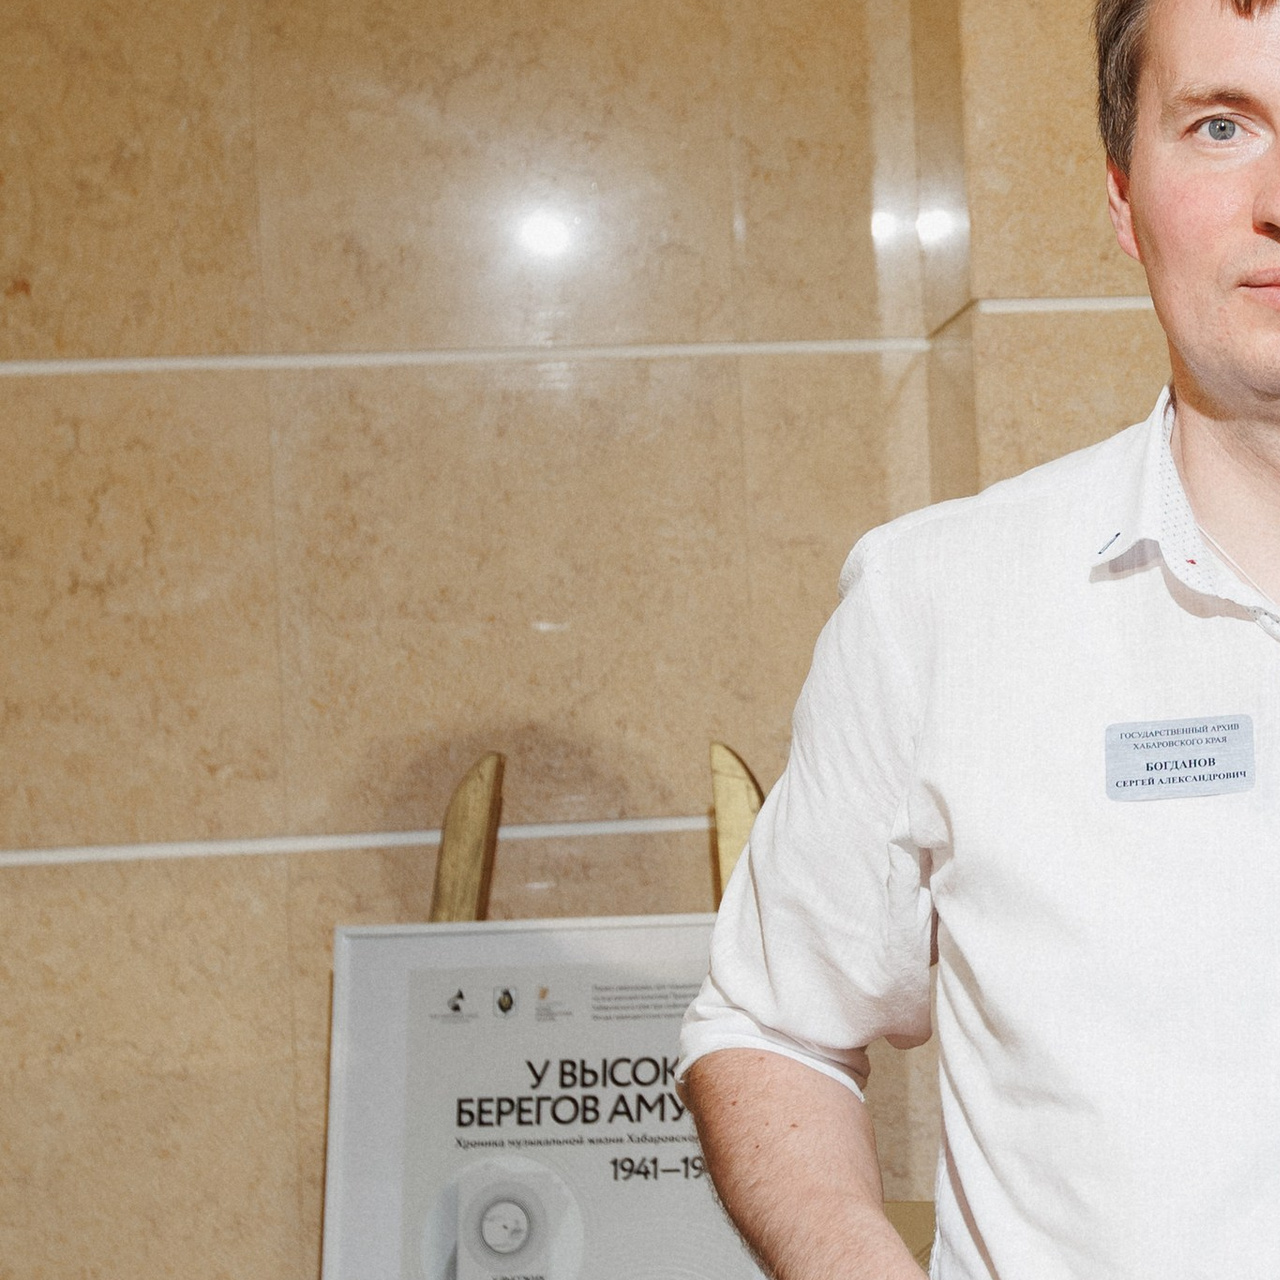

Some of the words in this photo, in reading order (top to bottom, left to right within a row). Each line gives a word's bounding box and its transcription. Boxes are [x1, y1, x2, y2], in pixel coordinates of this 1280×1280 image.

[1120, 725, 1209, 739] ГОСУДАРСТВЕННЫЙ
[1210, 723, 1240, 733] АРХИВ
[1133, 739, 1203, 750] ХАБАРОВСКОГО
[1205, 736, 1228, 745] КРАЯ
[1146, 757, 1216, 771] БОГДАНОВ
[1115, 777, 1155, 788] СЕРГЕЙ
[1157, 771, 1246, 785] АЛЕКСАНДРОВИЧ
[526, 1060, 549, 1089] У
[558, 1056, 680, 1089] ВЫСОК
[456, 1095, 600, 1127] БЕРЕГОВ
[608, 1093, 685, 1124] АМУ
[626, 1133, 699, 1145] Хабаровско
[610, 1156, 705, 1180] 1941—19
